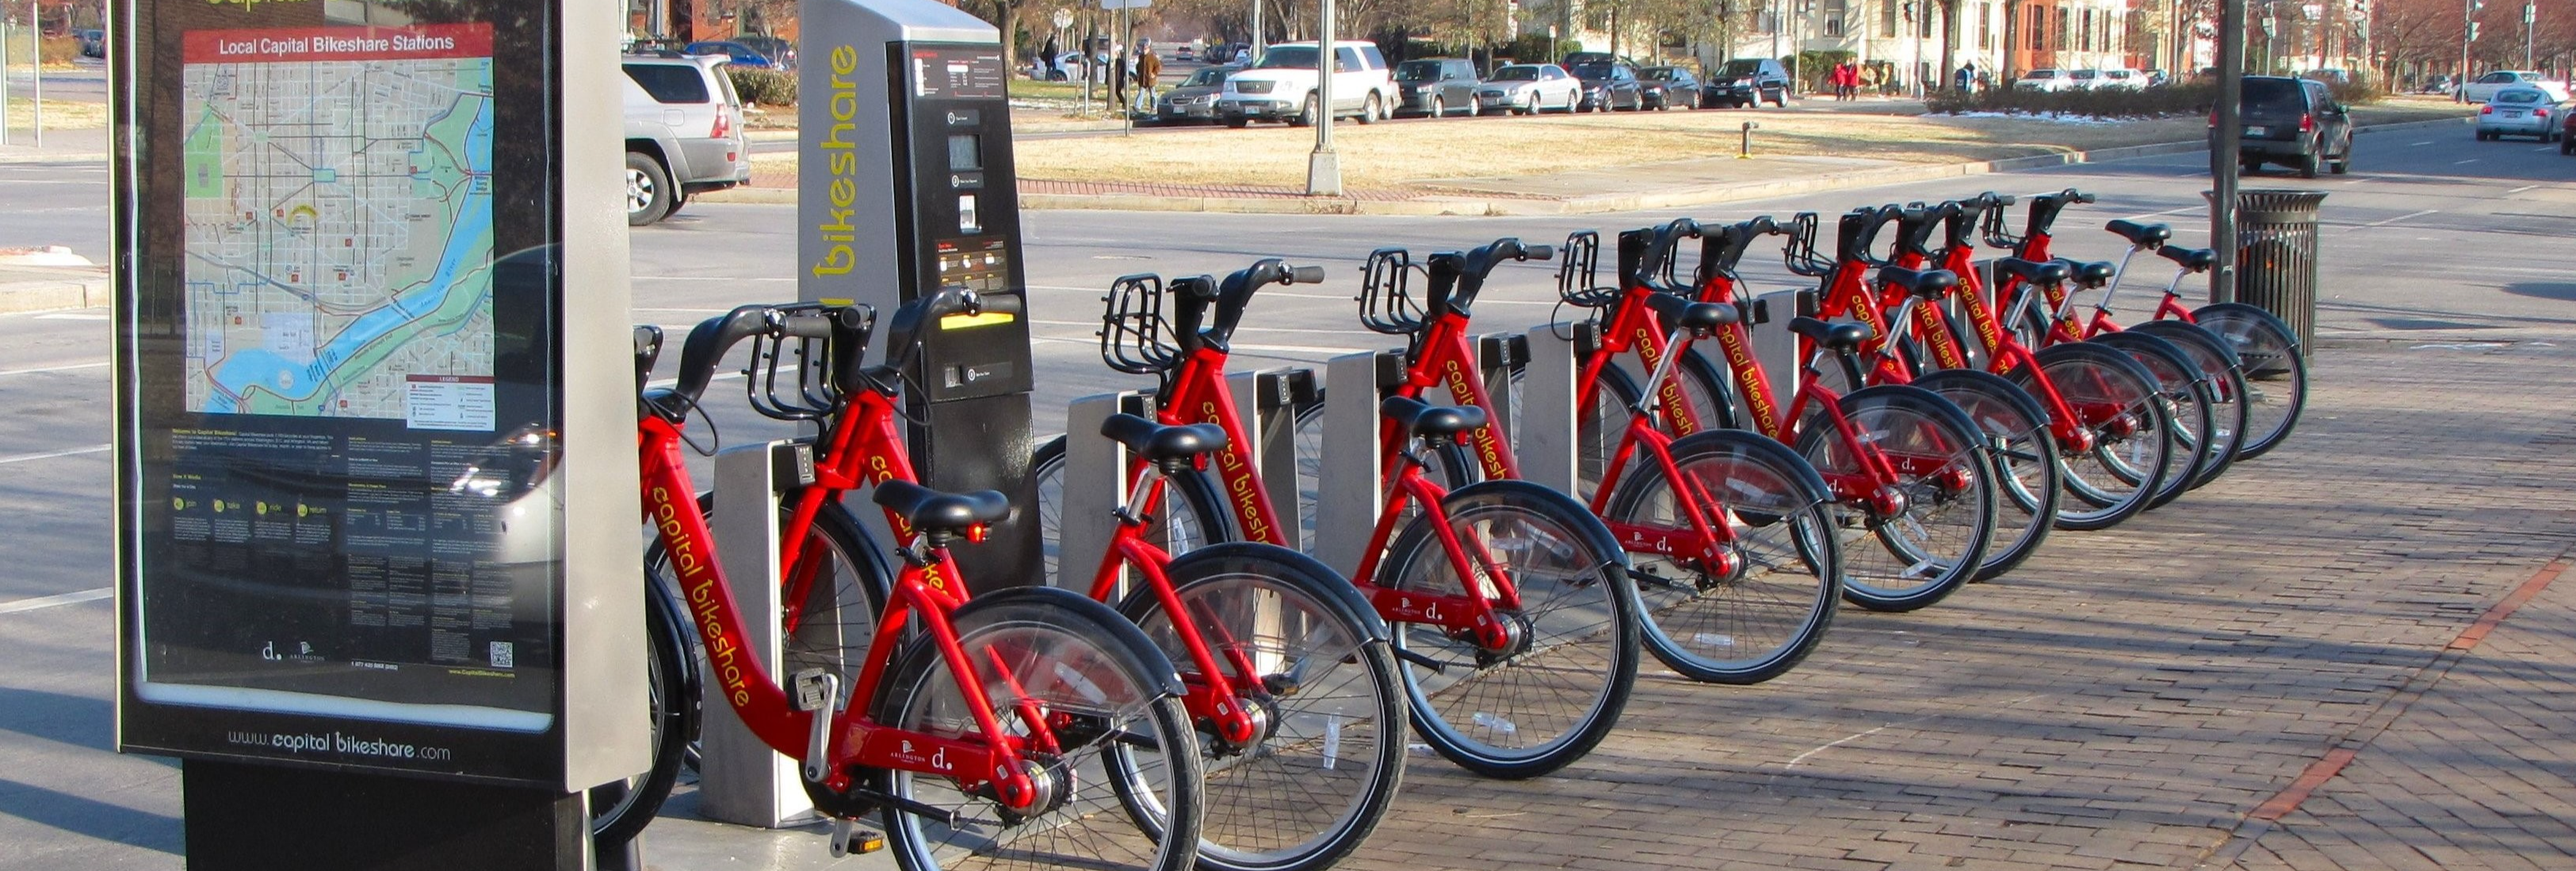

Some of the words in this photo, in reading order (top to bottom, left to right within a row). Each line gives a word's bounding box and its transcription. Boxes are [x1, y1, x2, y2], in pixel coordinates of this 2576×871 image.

[219, 38, 257, 55] Local
[260, 36, 308, 57] Capital
[313, 36, 389, 53] Bikeshare
[392, 34, 455, 52] Stations
[812, 44, 859, 279] bikeshare
[1932, 329, 1959, 369] bikesh
[1447, 359, 1476, 406] capit
[1474, 422, 1508, 480] bikesh
[1663, 381, 1694, 437] bikesh
[1741, 365, 1778, 439] bikeshare
[1233, 472, 1271, 545] bikesh
[652, 486, 704, 578] capital
[691, 577, 750, 708] bikeshare
[890, 752, 926, 763] ARLINGTON
